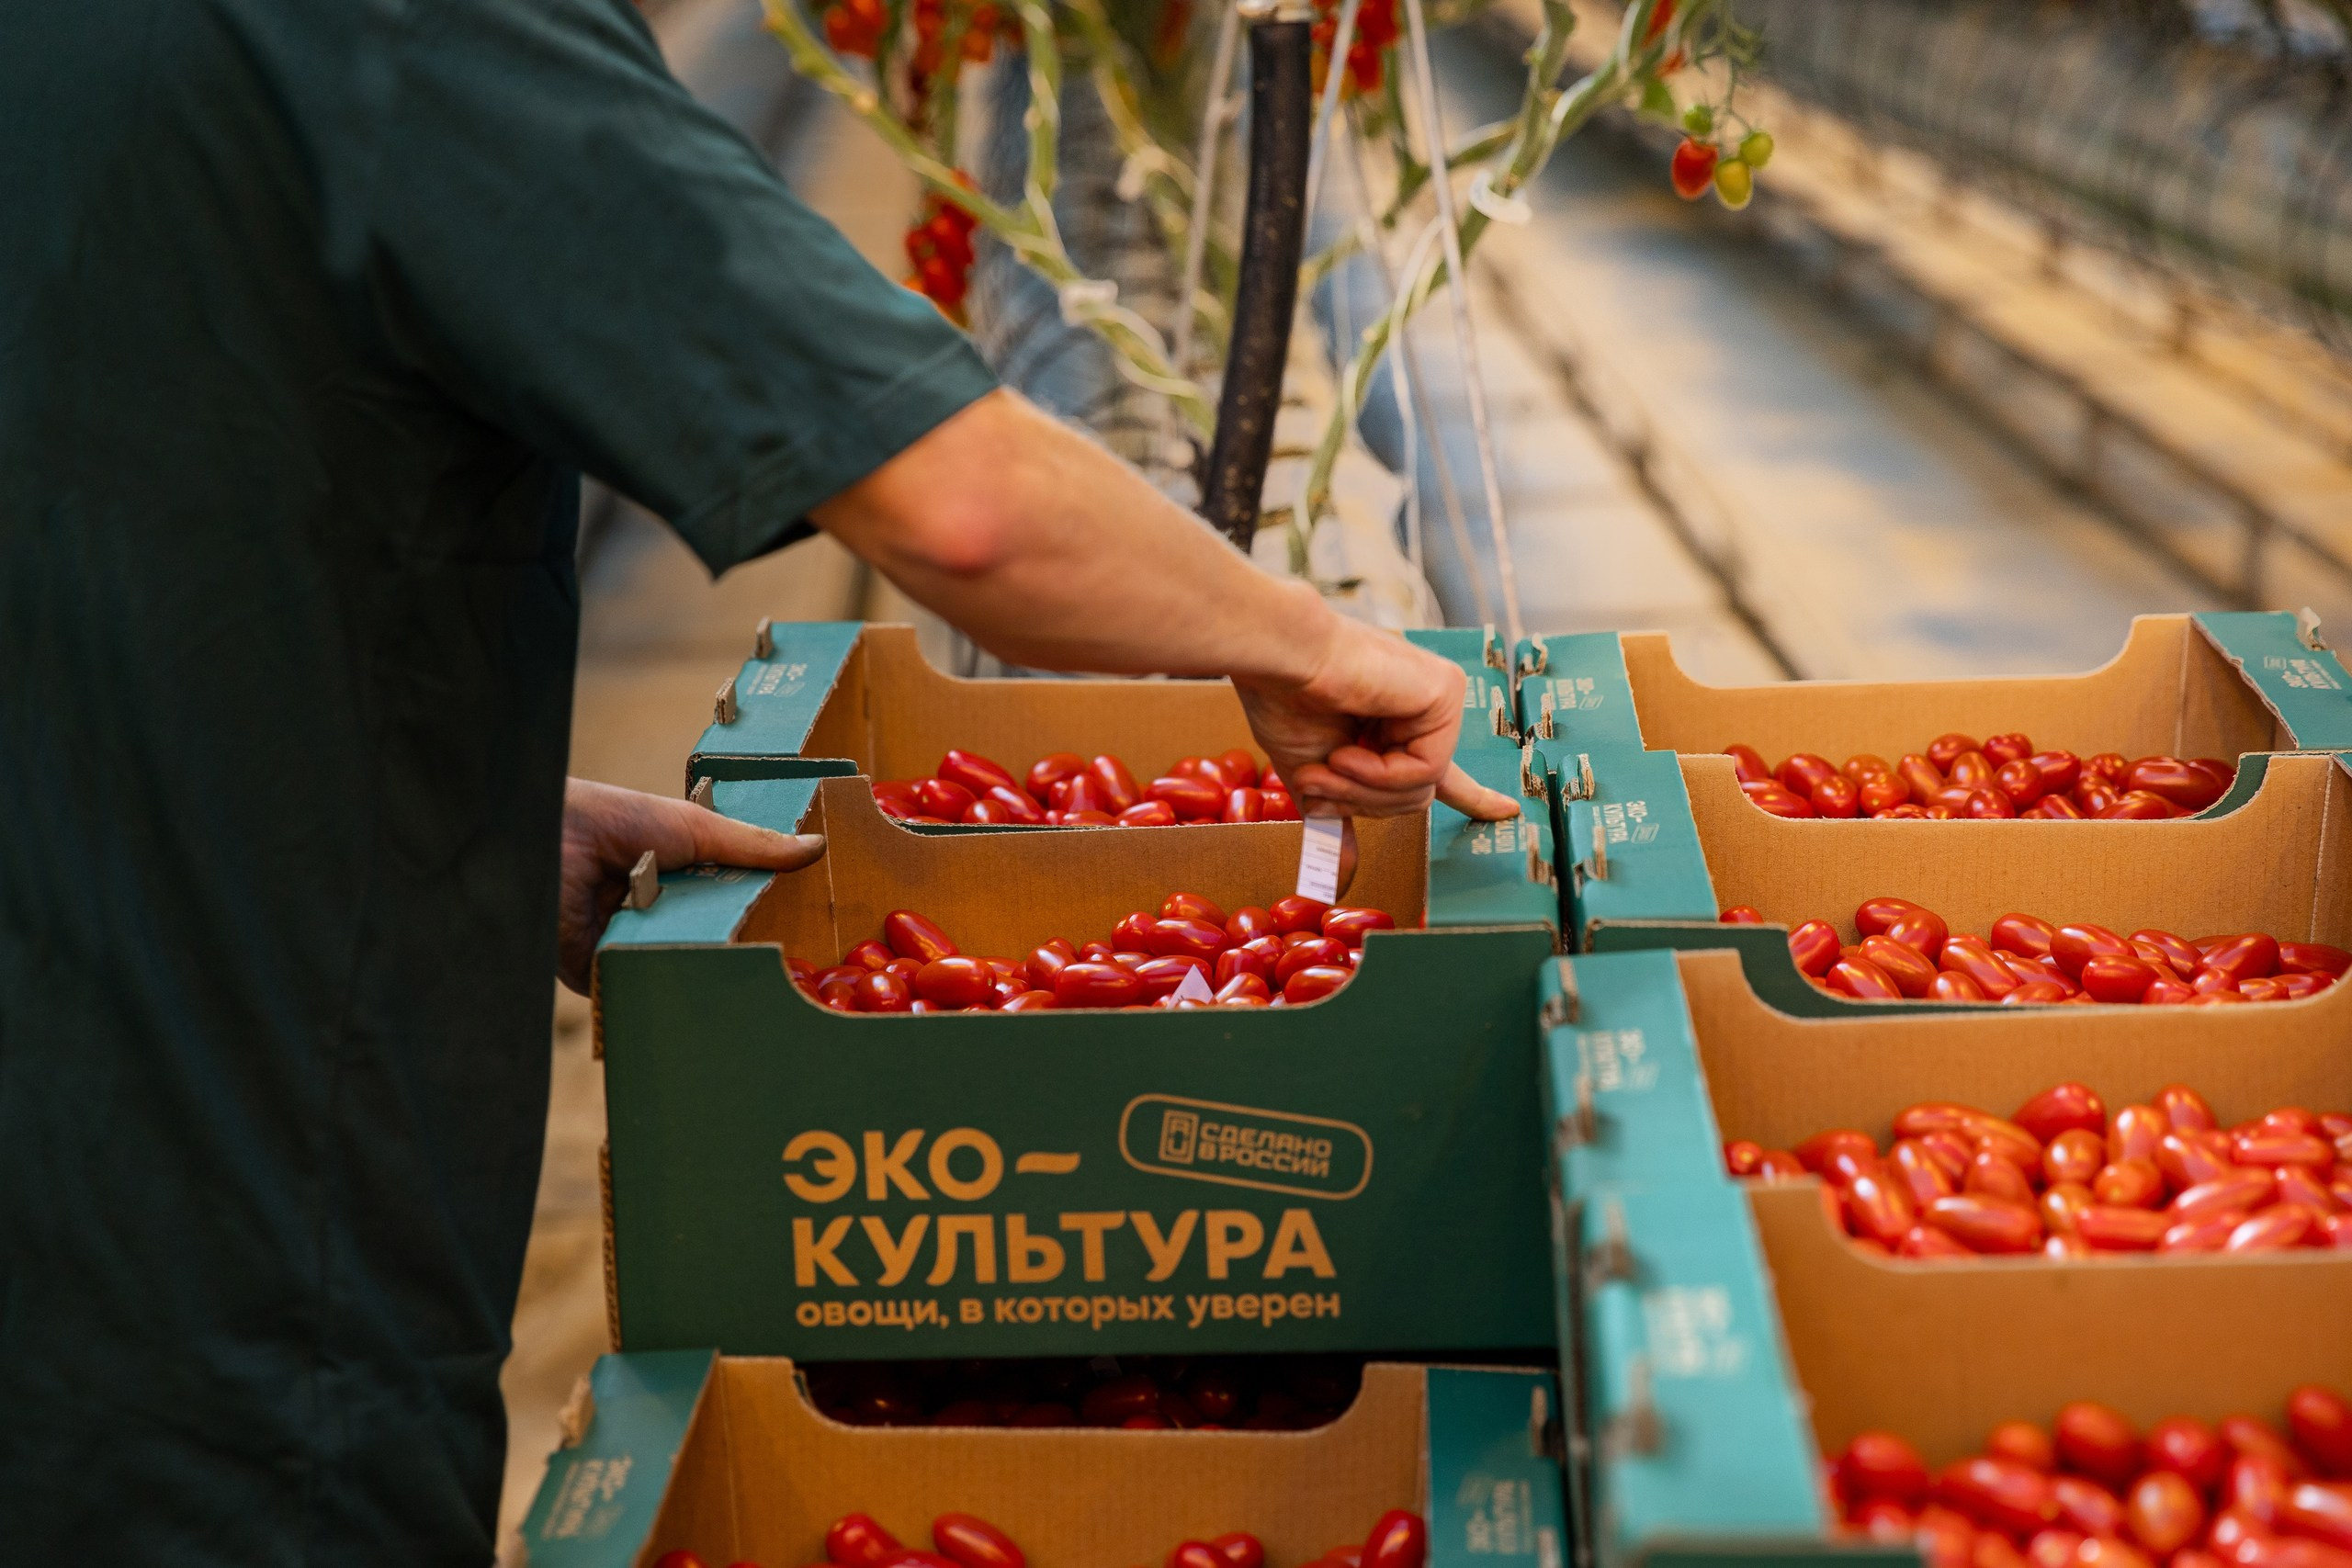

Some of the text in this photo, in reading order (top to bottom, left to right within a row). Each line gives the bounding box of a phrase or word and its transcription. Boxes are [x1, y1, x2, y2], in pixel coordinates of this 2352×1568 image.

[1200, 1122, 1332, 1158] СДЕЛАНО
[792, 1208, 1337, 1288] КУЛЬТУРА
[796, 1293, 1341, 1331] овощи, в которых уверен
